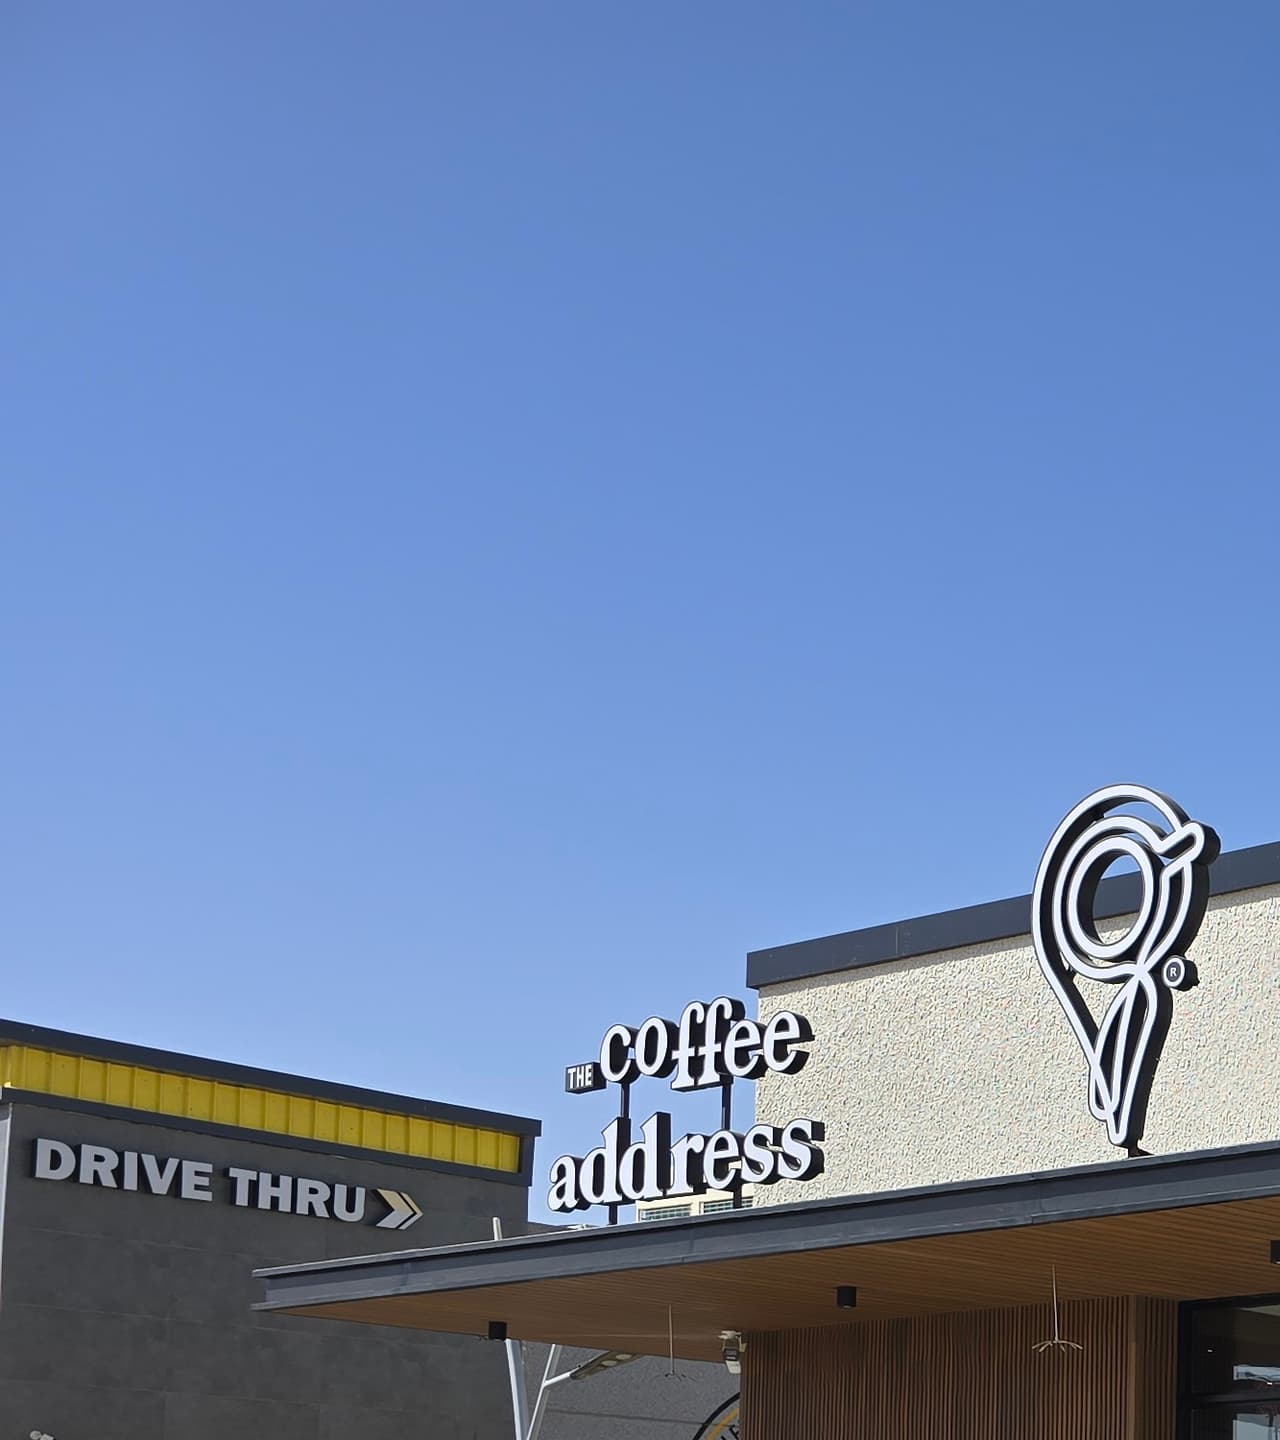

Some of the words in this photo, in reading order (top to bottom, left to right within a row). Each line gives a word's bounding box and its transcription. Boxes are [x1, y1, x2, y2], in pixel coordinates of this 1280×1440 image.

[566, 1066, 593, 1090] THE
[599, 996, 812, 1092] coffee
[34, 1137, 213, 1202] DRIVE
[227, 1166, 367, 1223] THRU
[548, 1111, 820, 1212] address
